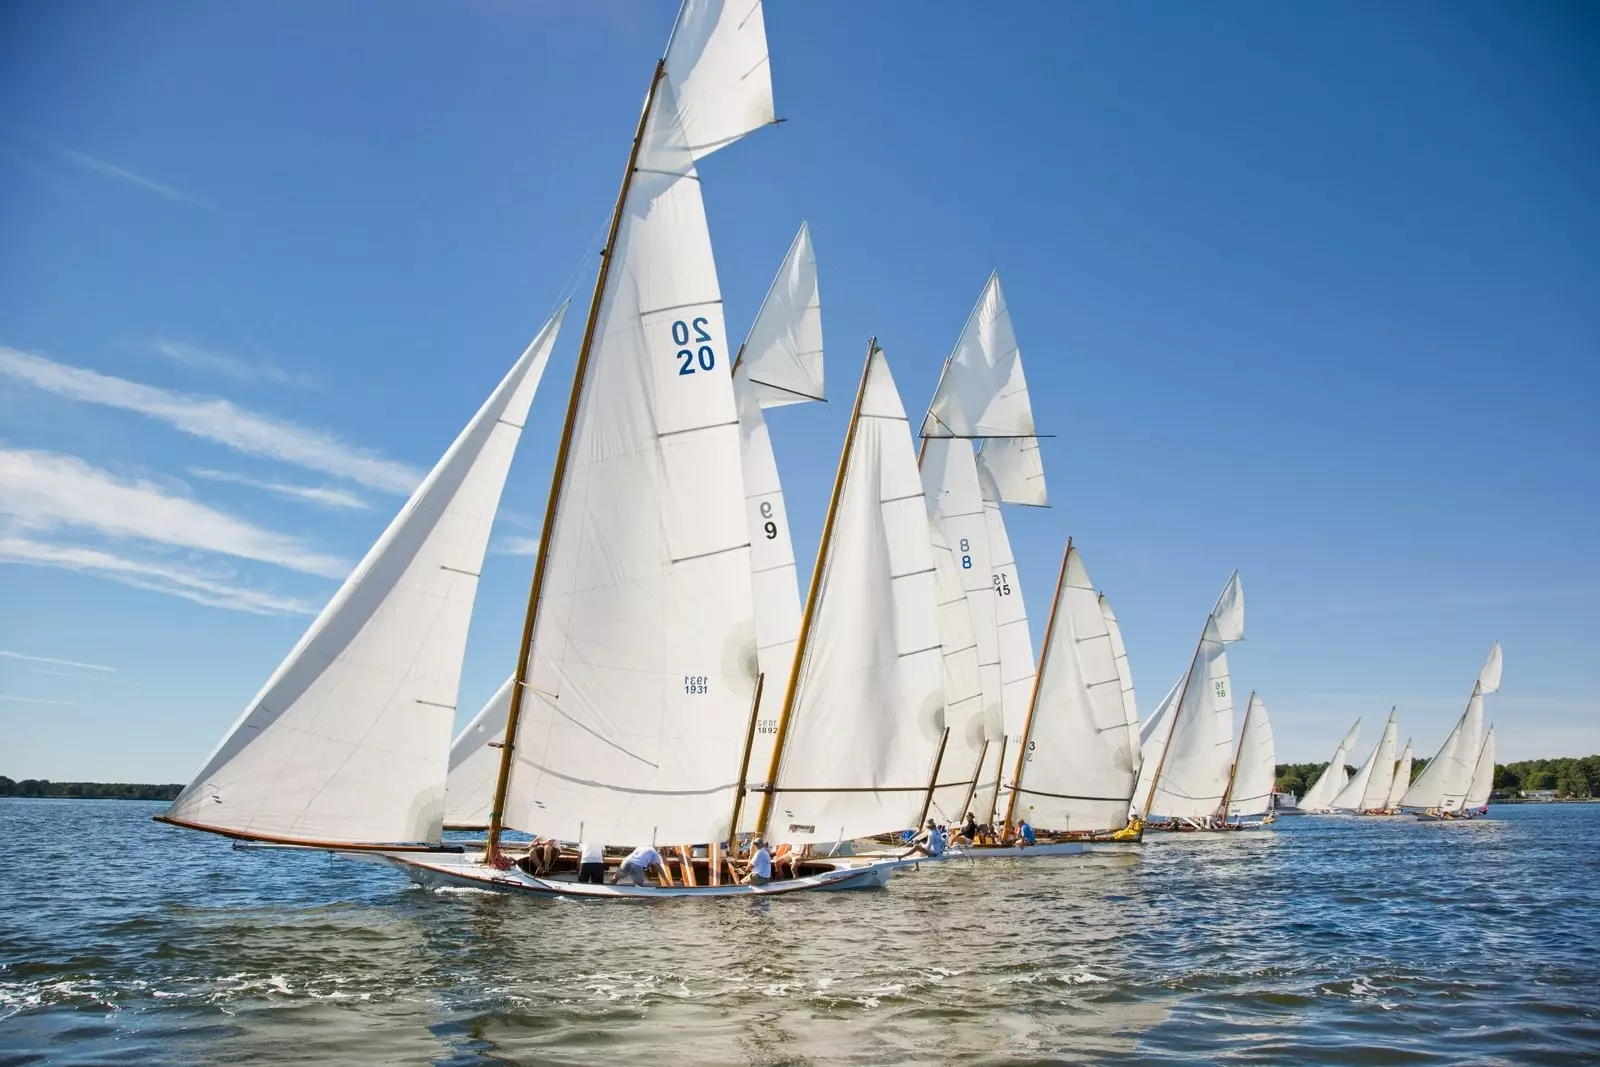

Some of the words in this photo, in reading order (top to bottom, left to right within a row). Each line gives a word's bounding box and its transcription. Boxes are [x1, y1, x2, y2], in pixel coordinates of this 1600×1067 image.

[677, 346, 714, 375] 20
[764, 521, 777, 540] 9
[960, 538, 970, 552] 8
[962, 555, 972, 569] 8
[996, 584, 1011, 597] 15
[684, 685, 708, 694] 1931
[1216, 689, 1226, 698] 16
[1029, 741, 1036, 751] 3
